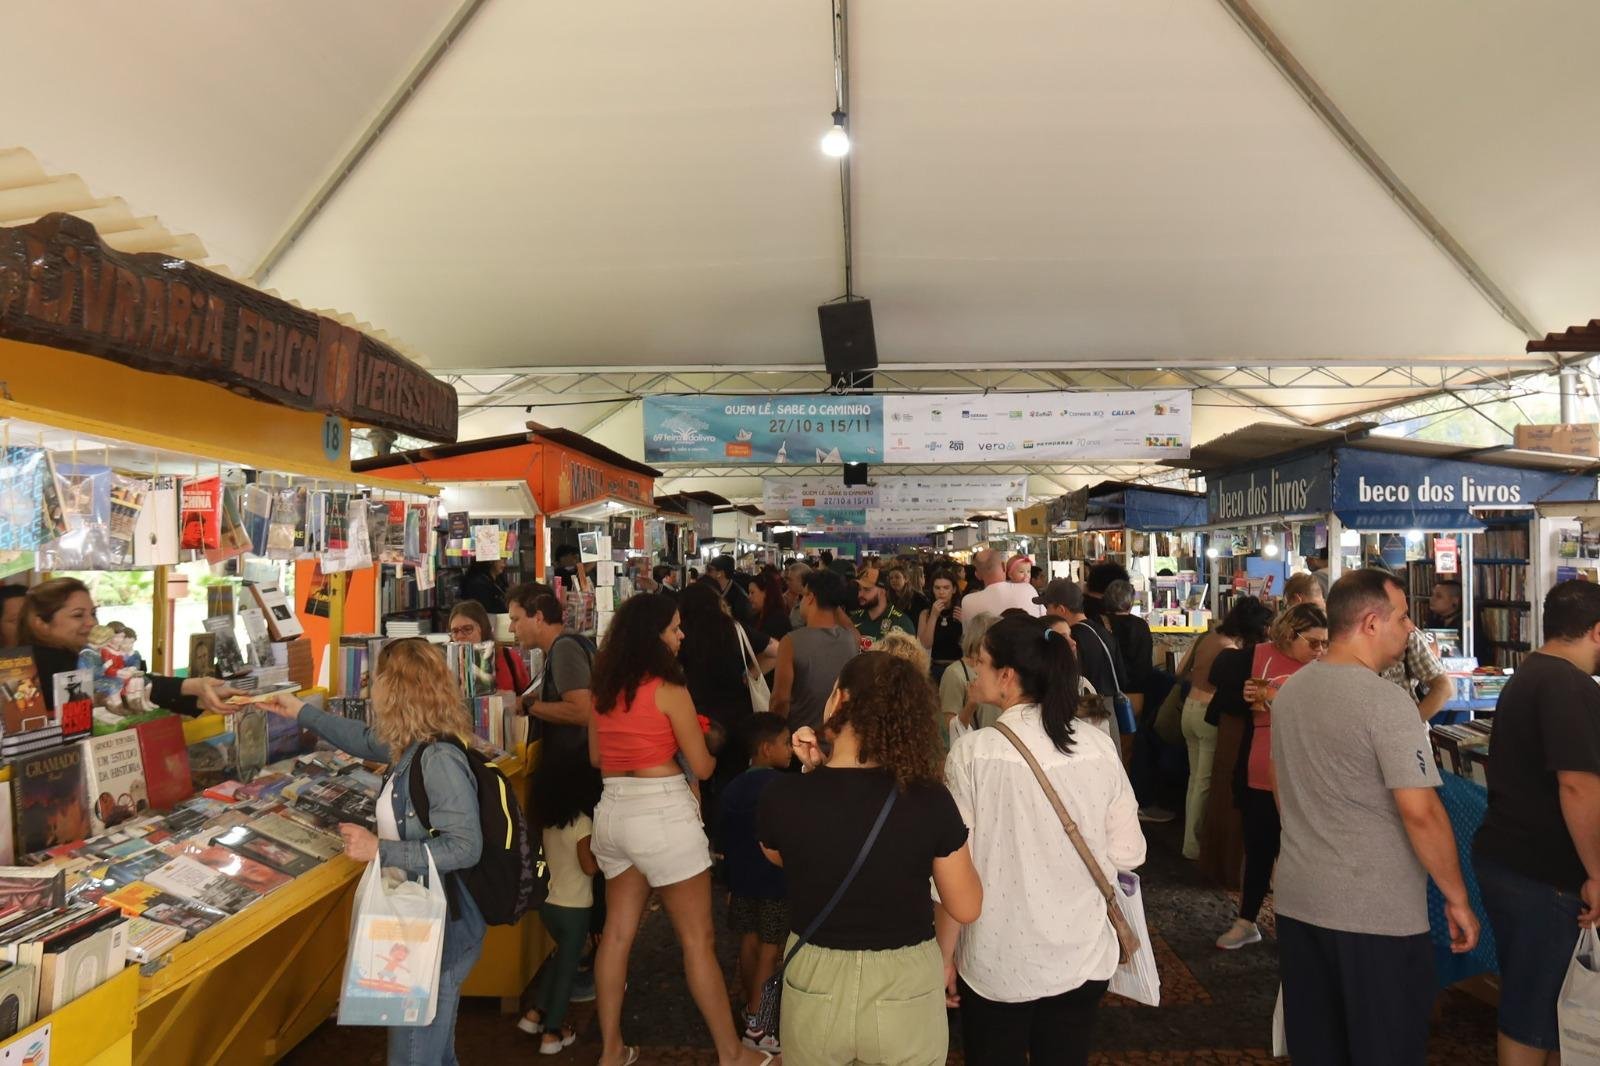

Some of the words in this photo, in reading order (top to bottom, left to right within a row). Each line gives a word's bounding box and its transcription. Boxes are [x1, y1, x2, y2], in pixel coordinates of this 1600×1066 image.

[231, 307, 319, 397] ERICO
[357, 351, 453, 432] VERISSIMO
[725, 405, 756, 415] QUEM
[777, 405, 805, 415] SABE
[808, 405, 816, 415] O
[820, 405, 871, 415] CAMINHO
[325, 421, 340, 451] 18
[769, 419, 812, 432] 27/10
[816, 421, 824, 432] a
[831, 419, 871, 432] 15/11
[1219, 480, 1244, 518] beco
[1248, 473, 1267, 515] dos
[1271, 468, 1306, 512] livros
[1359, 476, 1409, 502] beco
[1418, 476, 1454, 502] dos
[1462, 476, 1521, 502] livros
[26, 752, 80, 777] GRAMADO
